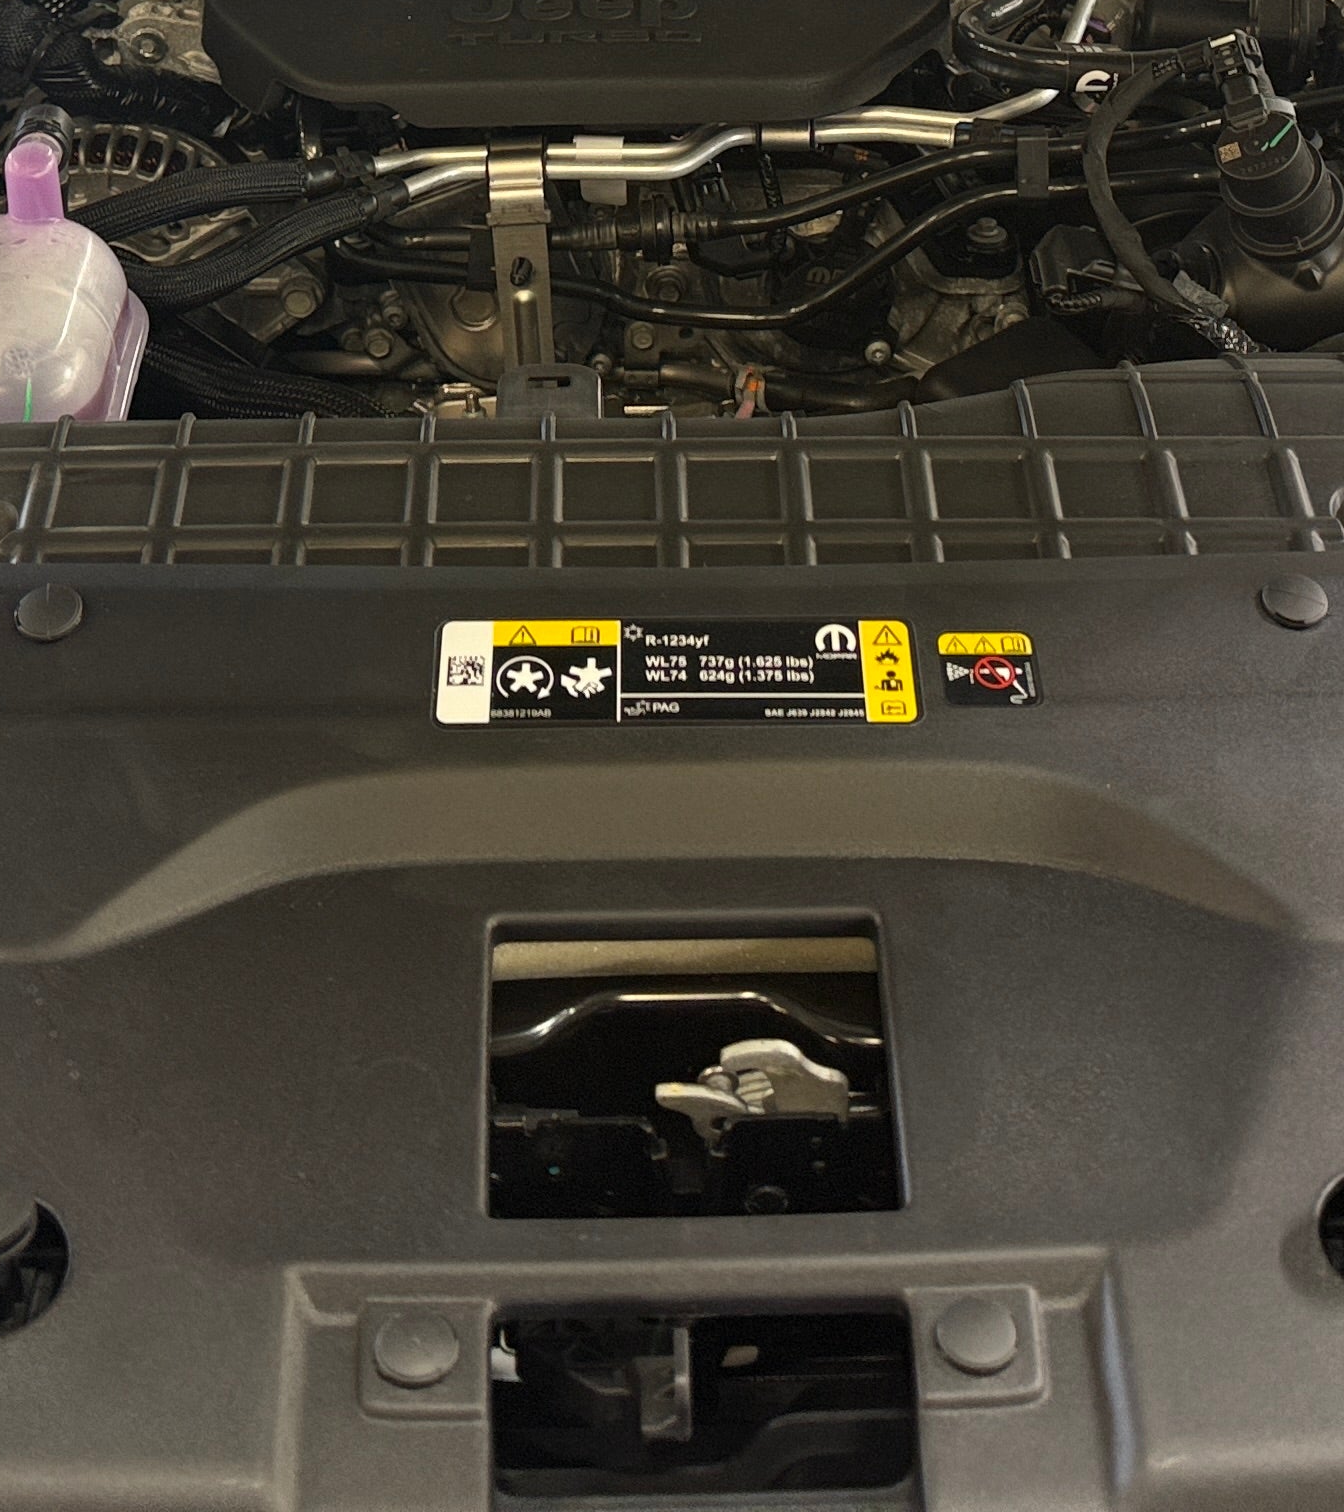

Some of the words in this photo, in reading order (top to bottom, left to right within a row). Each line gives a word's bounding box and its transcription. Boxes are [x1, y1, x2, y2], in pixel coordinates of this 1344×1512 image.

[447, 29, 703, 47] TURBO
[645, 633, 710, 650] R-1234yf
[645, 654, 688, 668] WL75
[698, 654, 735, 670] 737g
[738, 654, 783, 670] (1.625
[785, 654, 814, 670] lbs)
[645, 669, 688, 682] WL74
[699, 669, 736, 684] 624g
[738, 669, 784, 685] (1.375
[786, 669, 815, 685] lbs)
[652, 701, 681, 714] PAG
